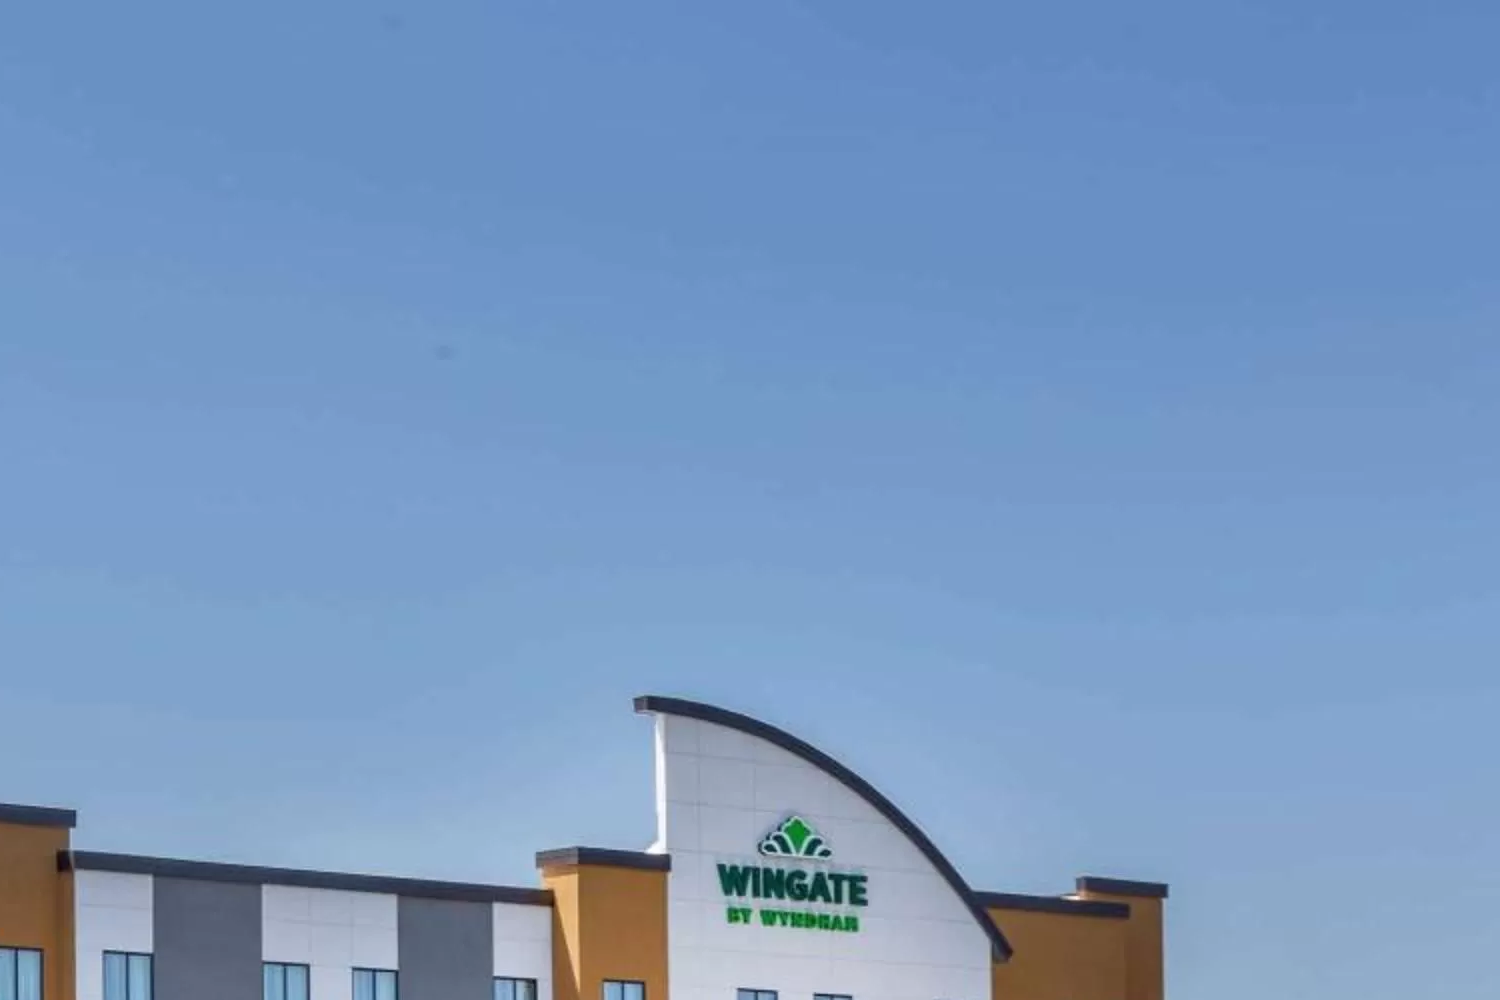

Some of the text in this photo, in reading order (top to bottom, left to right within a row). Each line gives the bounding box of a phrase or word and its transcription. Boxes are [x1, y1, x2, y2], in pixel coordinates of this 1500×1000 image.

[716, 863, 868, 907] WINGATE
[726, 907, 859, 932] BY WYNDHAM
